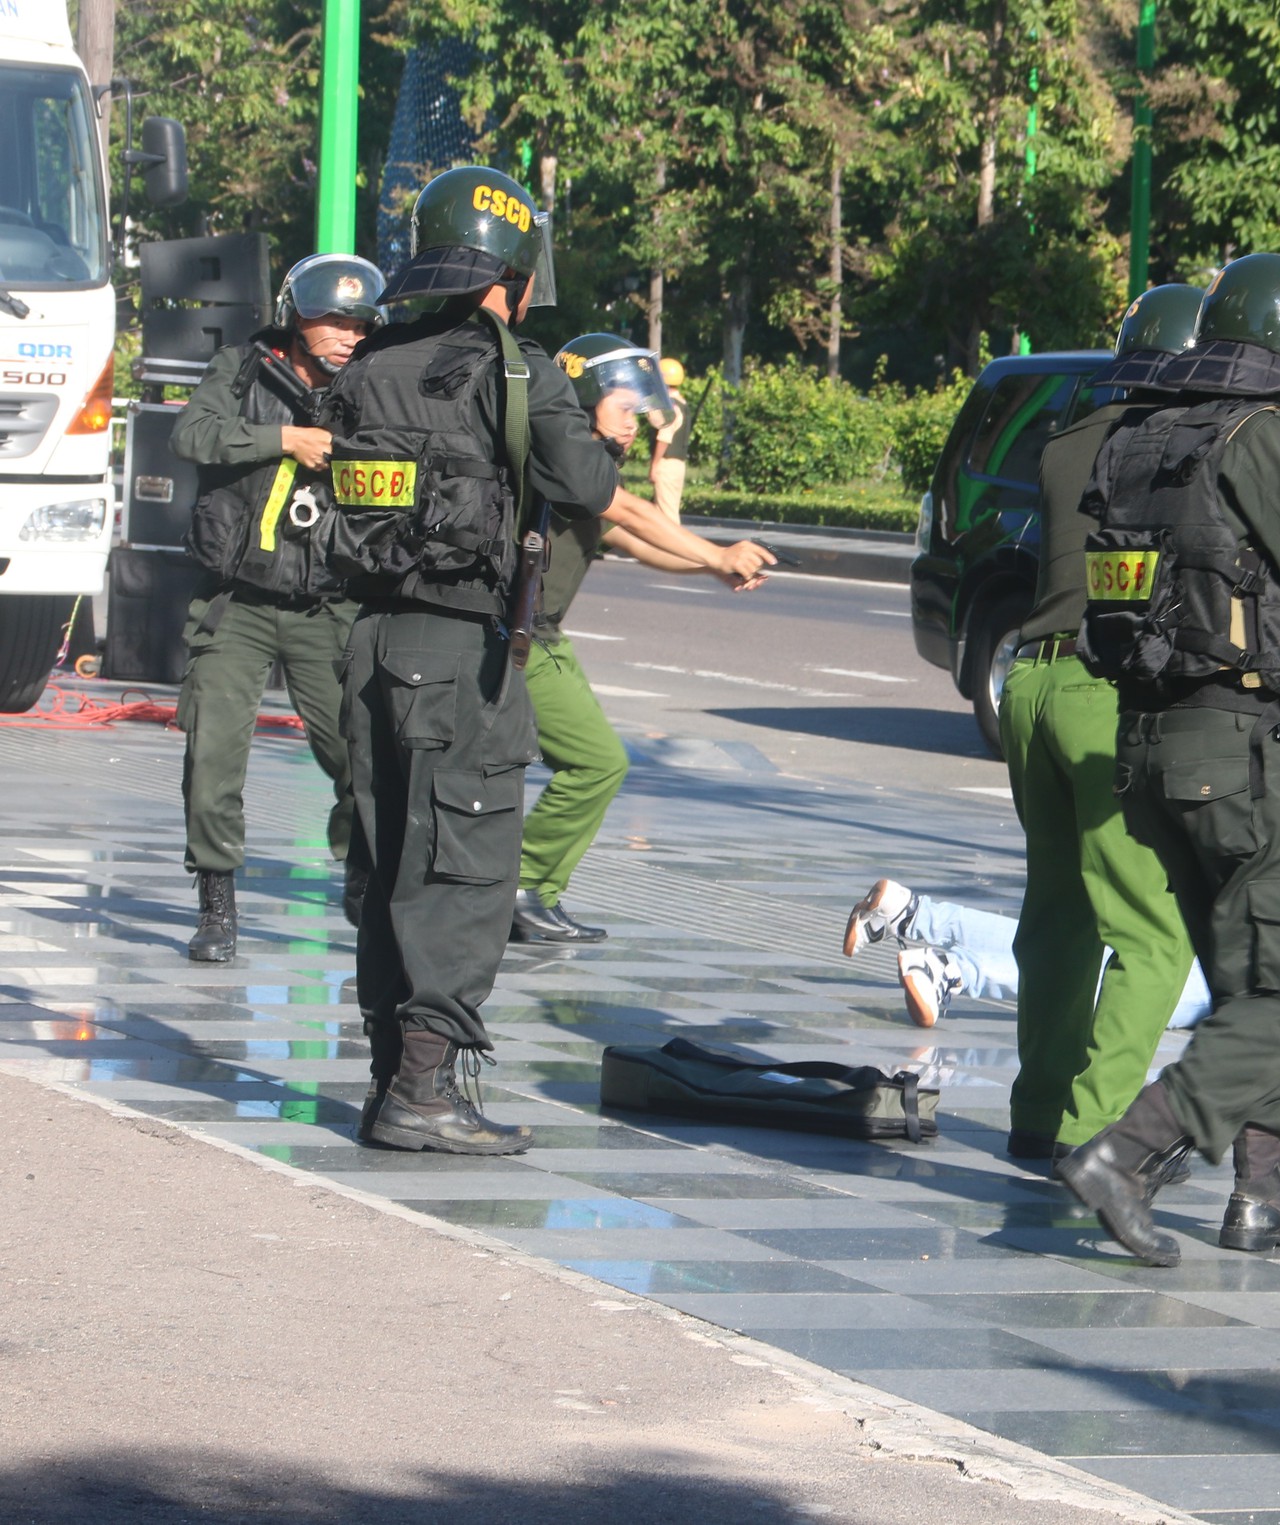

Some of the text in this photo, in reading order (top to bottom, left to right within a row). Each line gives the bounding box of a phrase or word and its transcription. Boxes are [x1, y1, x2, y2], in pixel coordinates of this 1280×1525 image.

[18, 343, 72, 358] QDR
[3, 371, 66, 385] 500
[340, 468, 405, 497] CSCĐ
[1091, 561, 1146, 592] CSCĐ
